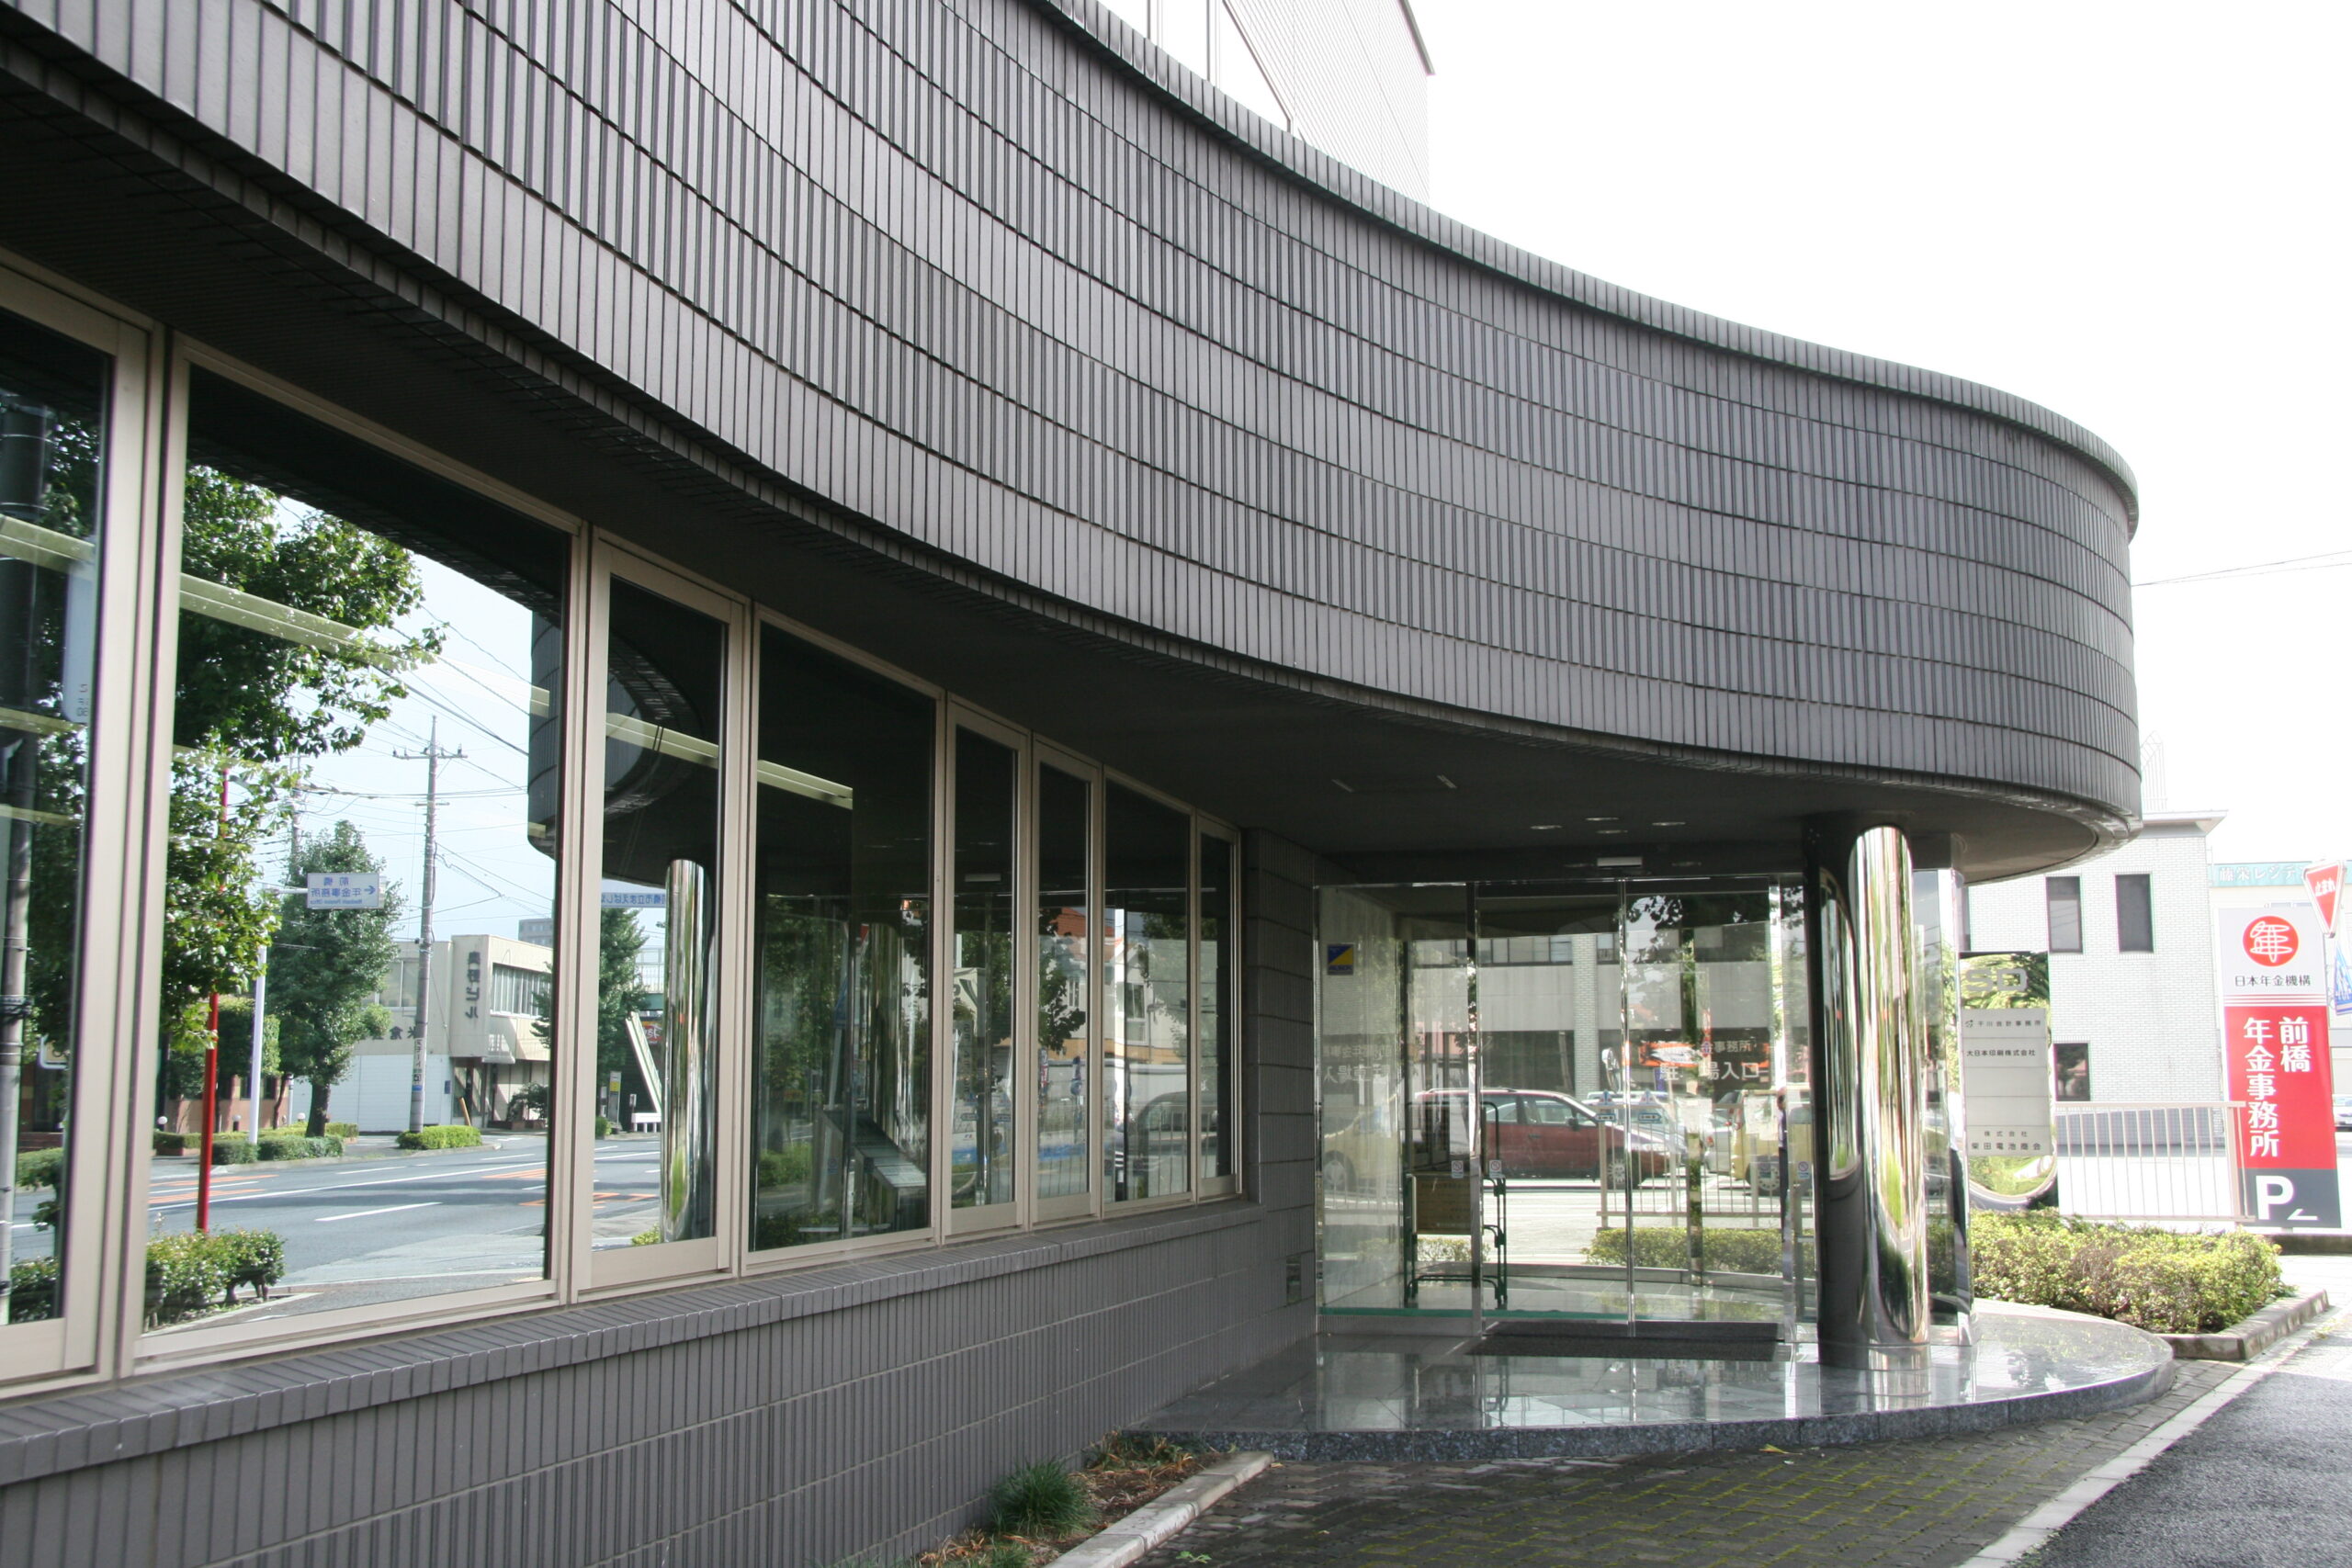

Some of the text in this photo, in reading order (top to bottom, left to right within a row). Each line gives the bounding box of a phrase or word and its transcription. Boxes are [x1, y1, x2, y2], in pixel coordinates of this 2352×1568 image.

[2219, 864, 2303, 882] 藤栄レジデ
[2315, 877, 2336, 897] 止まれ
[2234, 975, 2312, 987] 日本年金機構
[1966, 1049, 2036, 1057] 大日本印刷株式会社
[2278, 1016, 2312, 1073] 前橋
[1659, 1061, 1760, 1081] 駐場入口
[2243, 1017, 2280, 1158] 年金事務所
[2256, 1175, 2294, 1221] P
